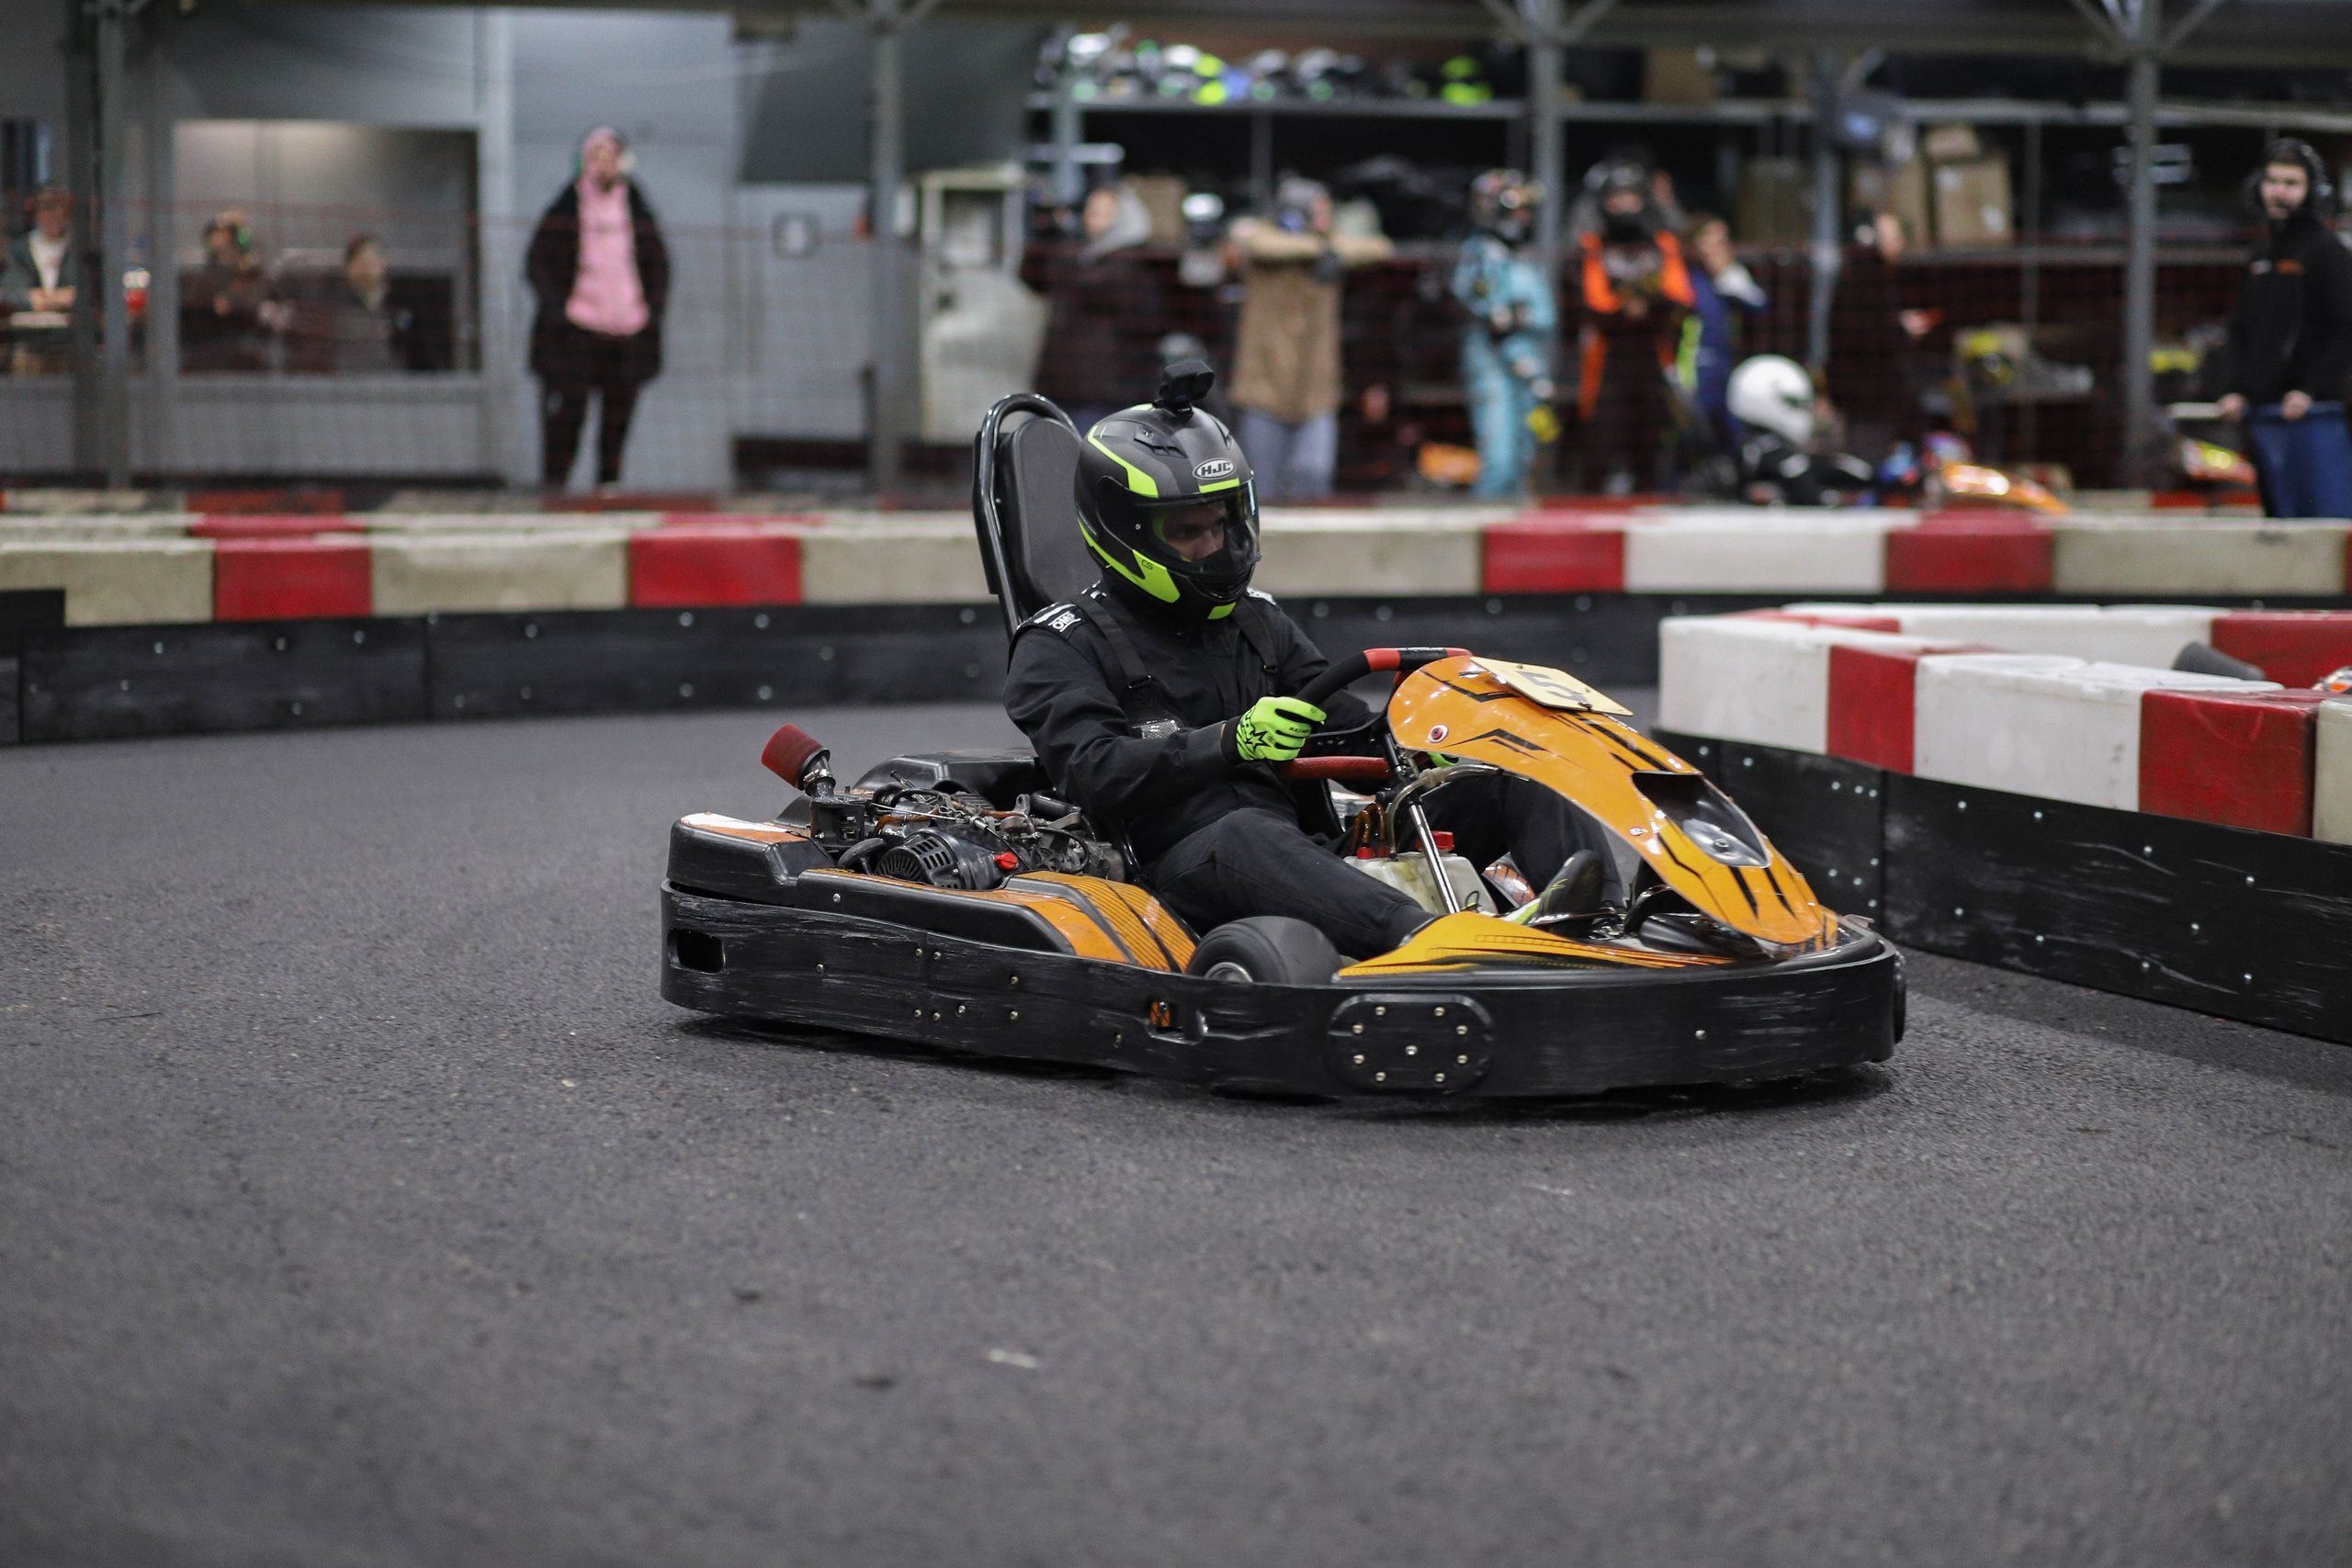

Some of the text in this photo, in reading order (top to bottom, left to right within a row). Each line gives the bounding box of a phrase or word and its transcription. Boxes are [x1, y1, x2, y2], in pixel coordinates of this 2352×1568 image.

[1201, 462, 1231, 477] HJC
[1051, 612, 1077, 630] OMP
[1516, 670, 1589, 704] 5
